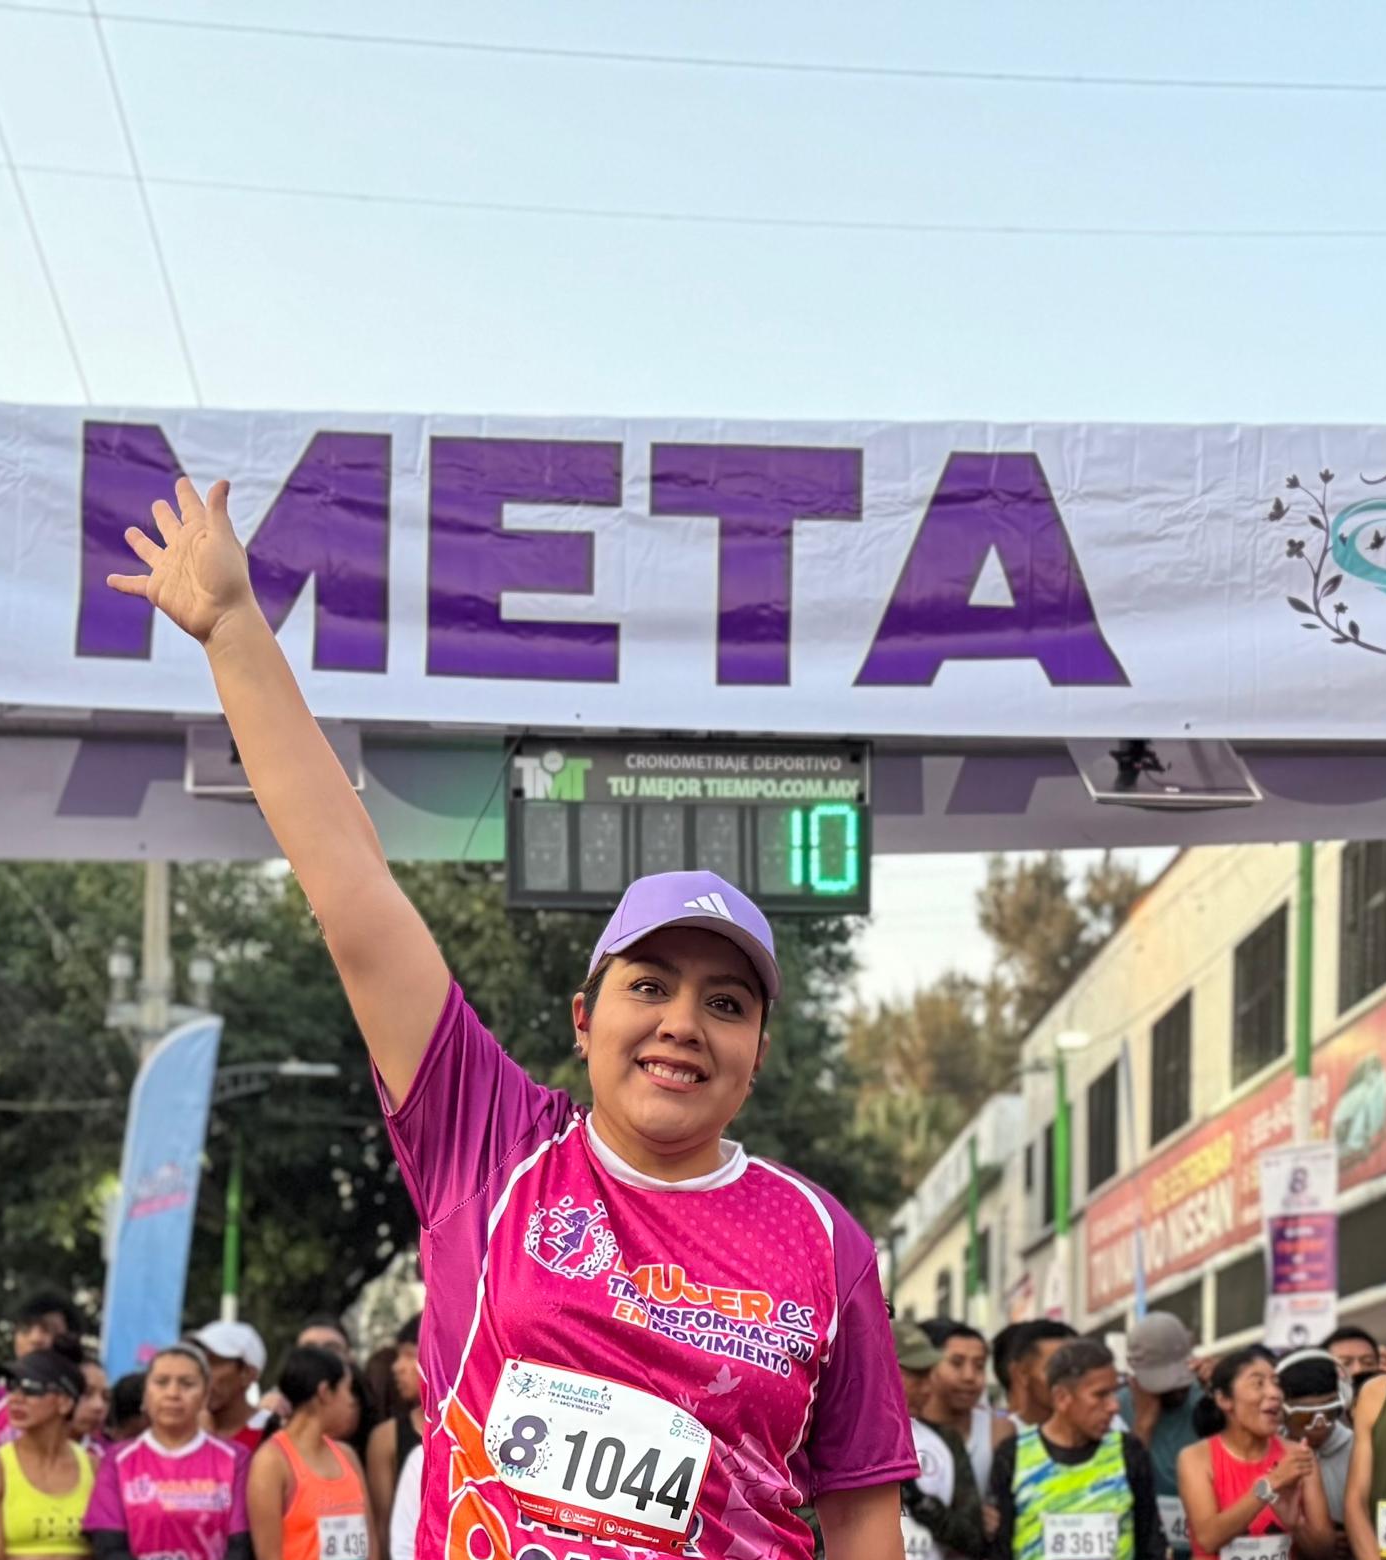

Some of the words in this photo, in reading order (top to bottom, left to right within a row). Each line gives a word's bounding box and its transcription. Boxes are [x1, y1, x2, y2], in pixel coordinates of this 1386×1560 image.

[74, 420, 1131, 688] META
[626, 753, 750, 772] CRONOMETRAJE
[753, 755, 842, 772] DEPORTIVO
[607, 776, 635, 798] TU
[638, 776, 701, 801] MEJOR
[703, 777, 860, 799] TIEMPO.COM.MX
[789, 804, 859, 892] 10
[619, 1258, 773, 1324] MUJER
[778, 1301, 815, 1331] es
[606, 1276, 816, 1362] TRANSFORMACIÓN
[611, 1302, 647, 1328] EN
[649, 1316, 794, 1379] MOVIMIENTO
[549, 1380, 600, 1401] MUJER
[669, 1410, 685, 1438] SOY
[499, 1415, 549, 1468] 8
[562, 1430, 697, 1521] 1044
[500, 1462, 525, 1479] KM
[344, 1534, 367, 1557] 436
[1051, 1533, 1066, 1554] 8
[1069, 1532, 1115, 1555] 3615
